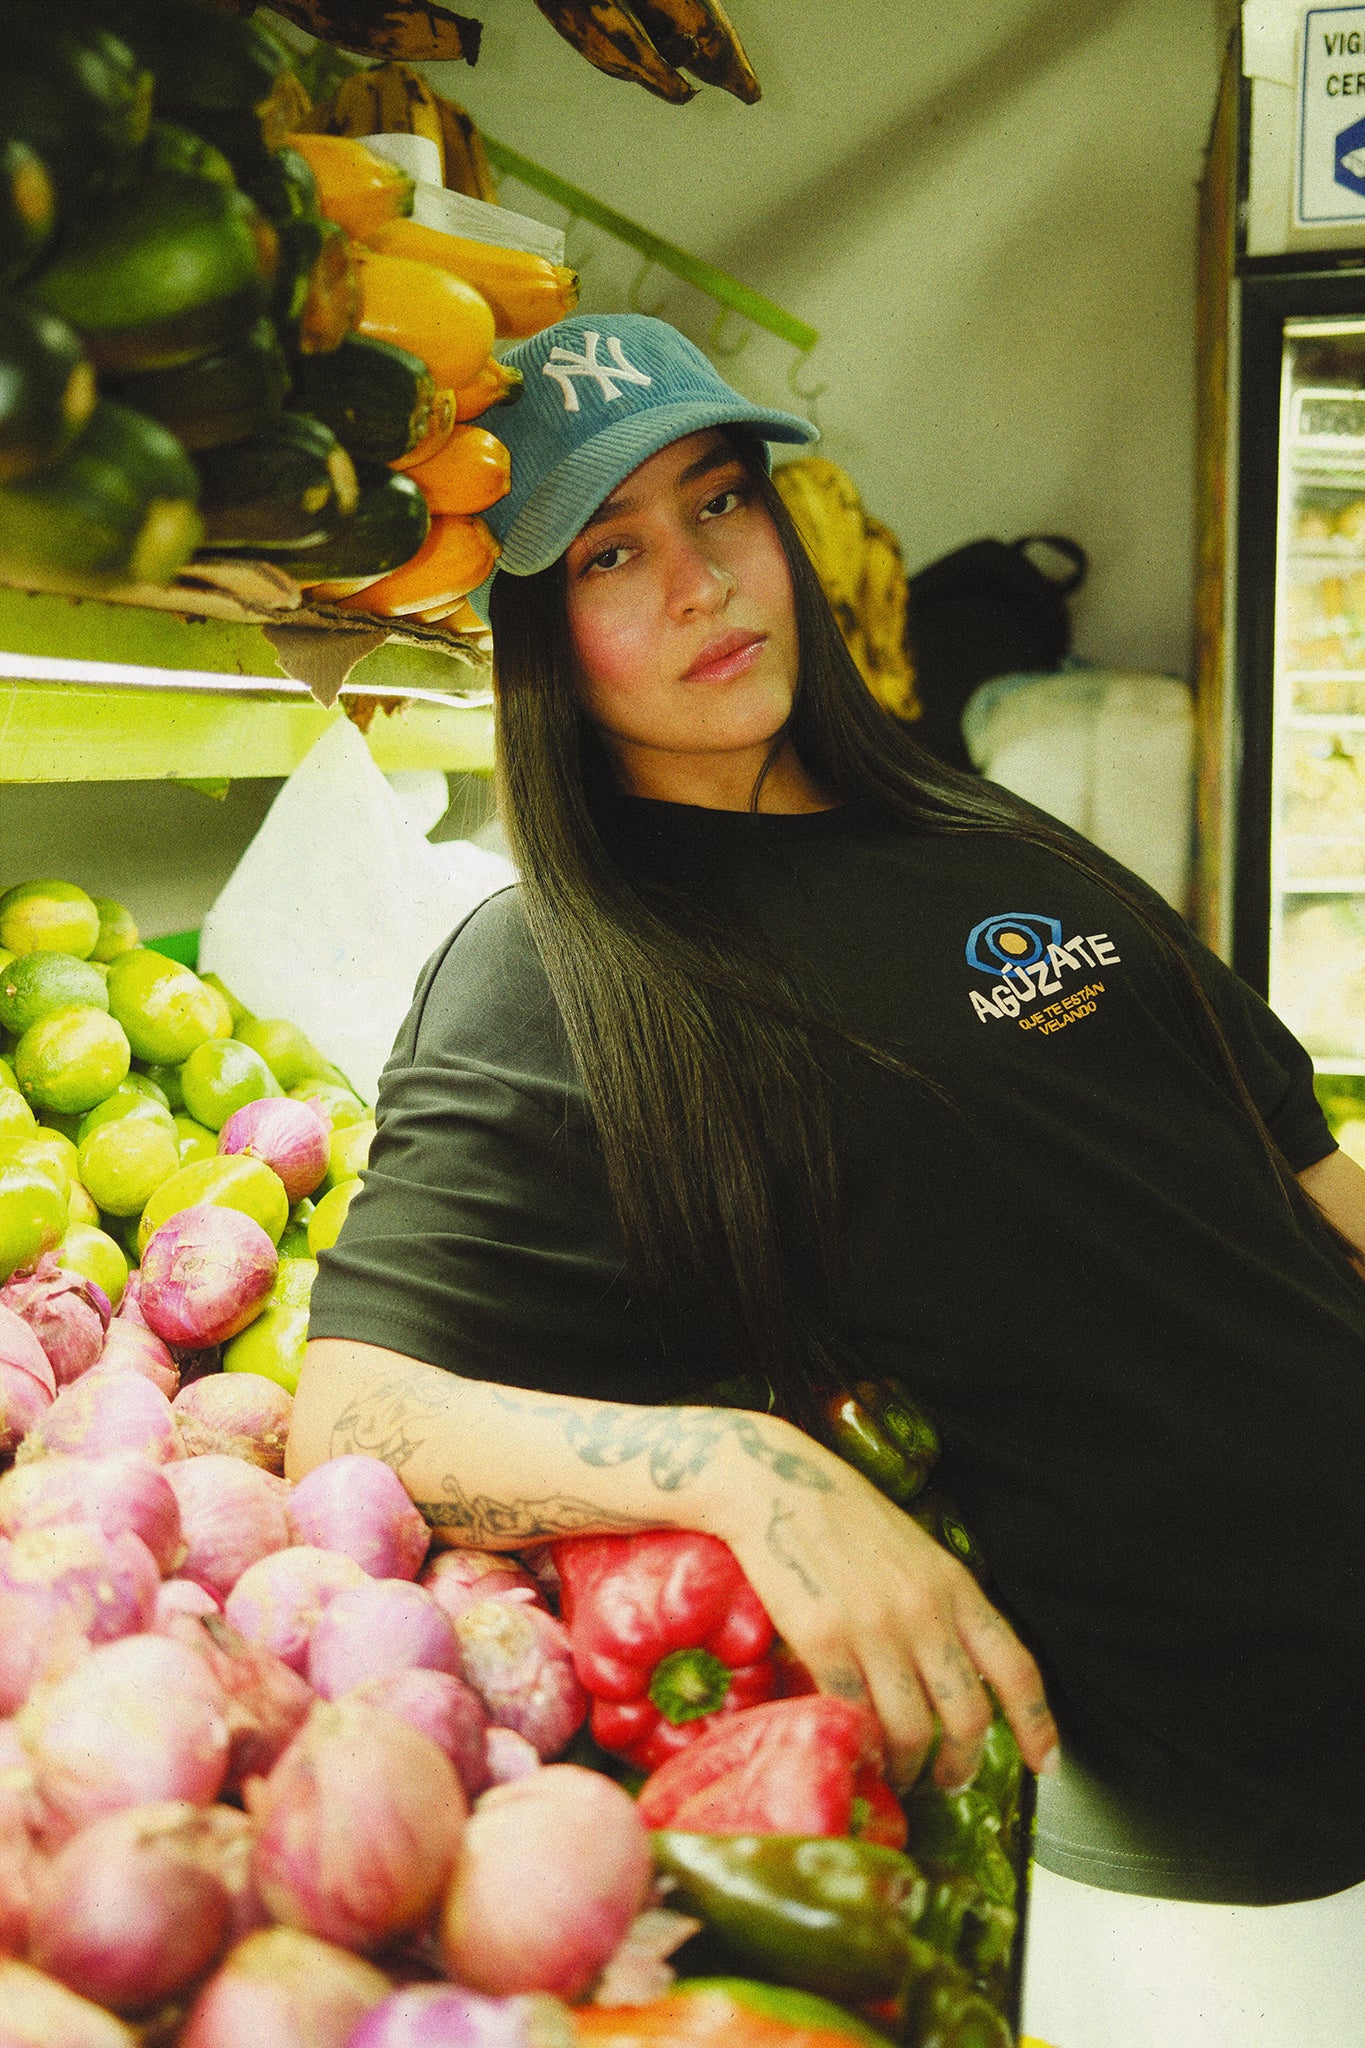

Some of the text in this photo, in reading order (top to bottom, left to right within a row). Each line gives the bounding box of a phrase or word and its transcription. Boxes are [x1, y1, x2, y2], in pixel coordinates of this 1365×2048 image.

[1324, 32, 1365, 56] VIG
[543, 331, 651, 412] NY
[968, 933, 1121, 1023] AGÚZATE
[1018, 982, 1105, 1031] QUE TE ESTÁN
[1038, 1001, 1098, 1036] VELANDO
